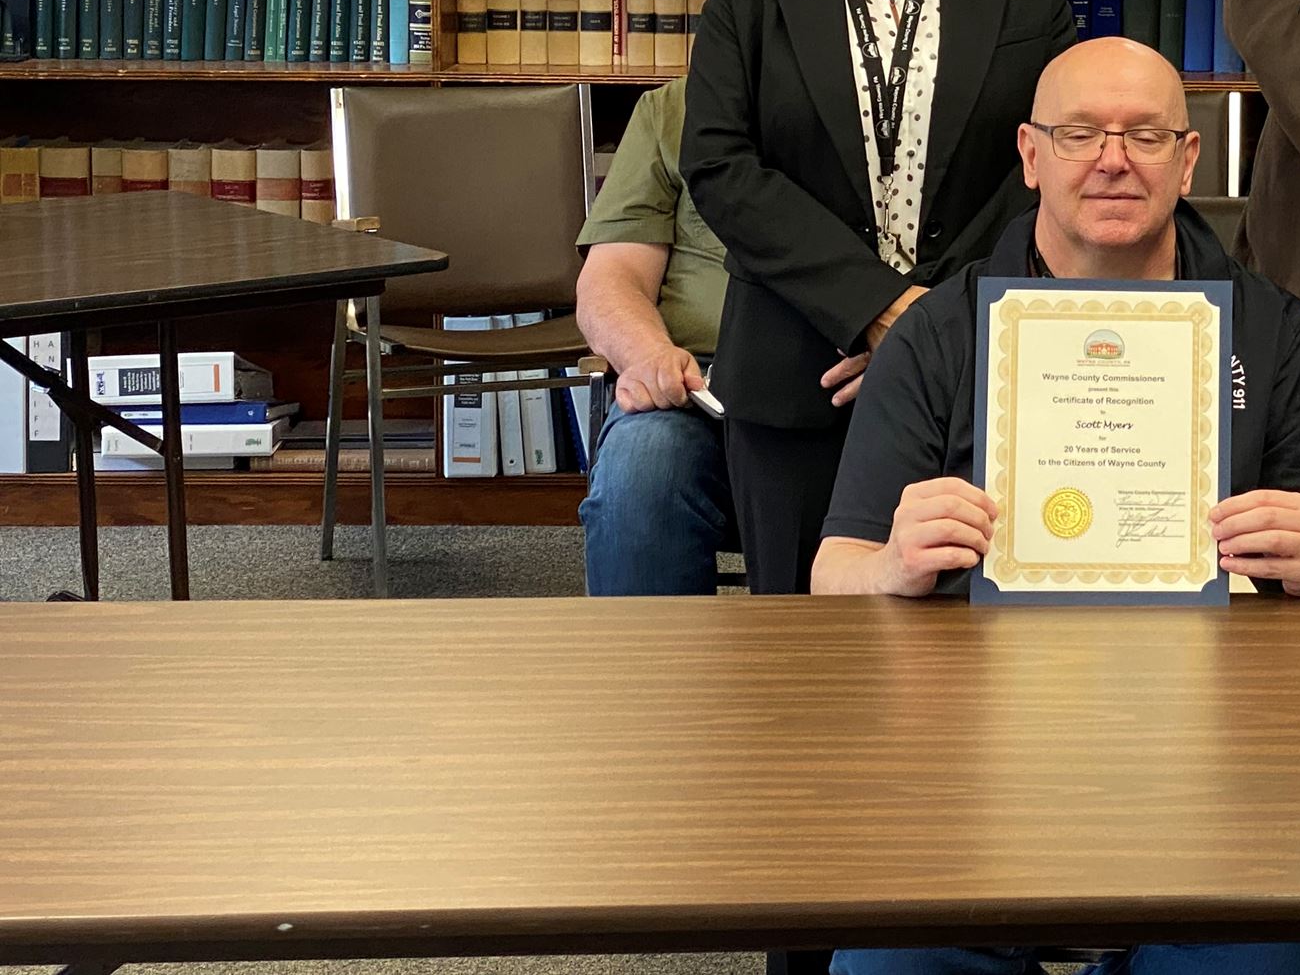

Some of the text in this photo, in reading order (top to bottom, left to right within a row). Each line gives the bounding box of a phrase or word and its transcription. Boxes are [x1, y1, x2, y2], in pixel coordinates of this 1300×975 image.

[1042, 373, 1165, 383] Wayne County Commissioners
[1231, 355, 1245, 409] NTY 911
[1052, 396, 1154, 407] Certificate of Recognition
[1075, 420, 1133, 431] Scott Myers
[1064, 446, 1074, 454] 20
[1075, 446, 1099, 454] Years
[1111, 446, 1141, 454] Service
[1048, 459, 1062, 467] the
[1063, 459, 1096, 467] Citizens
[1097, 459, 1107, 467] of
[1108, 459, 1135, 469] Wayne
[1137, 459, 1166, 469] County
